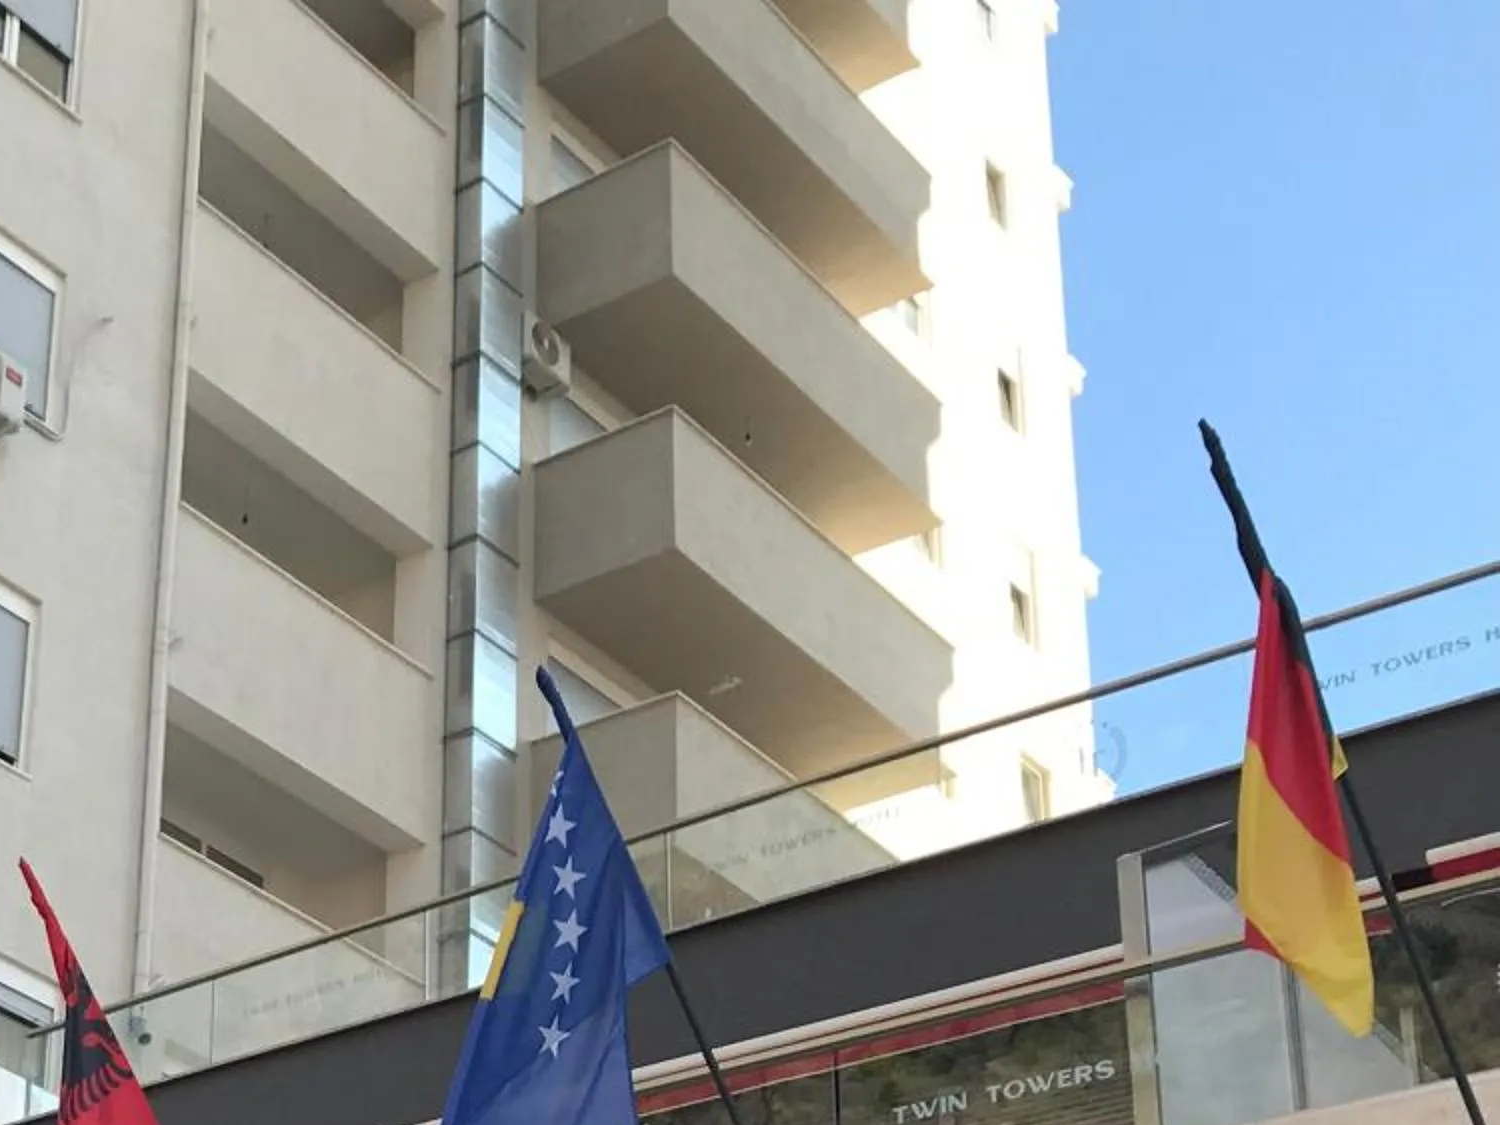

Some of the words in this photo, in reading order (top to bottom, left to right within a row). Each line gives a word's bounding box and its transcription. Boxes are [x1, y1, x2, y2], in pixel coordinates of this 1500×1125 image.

[1370, 635, 1472, 676] TOWERS
[892, 1091, 968, 1125] TWIN
[986, 1059, 1116, 1104] TOWERS
